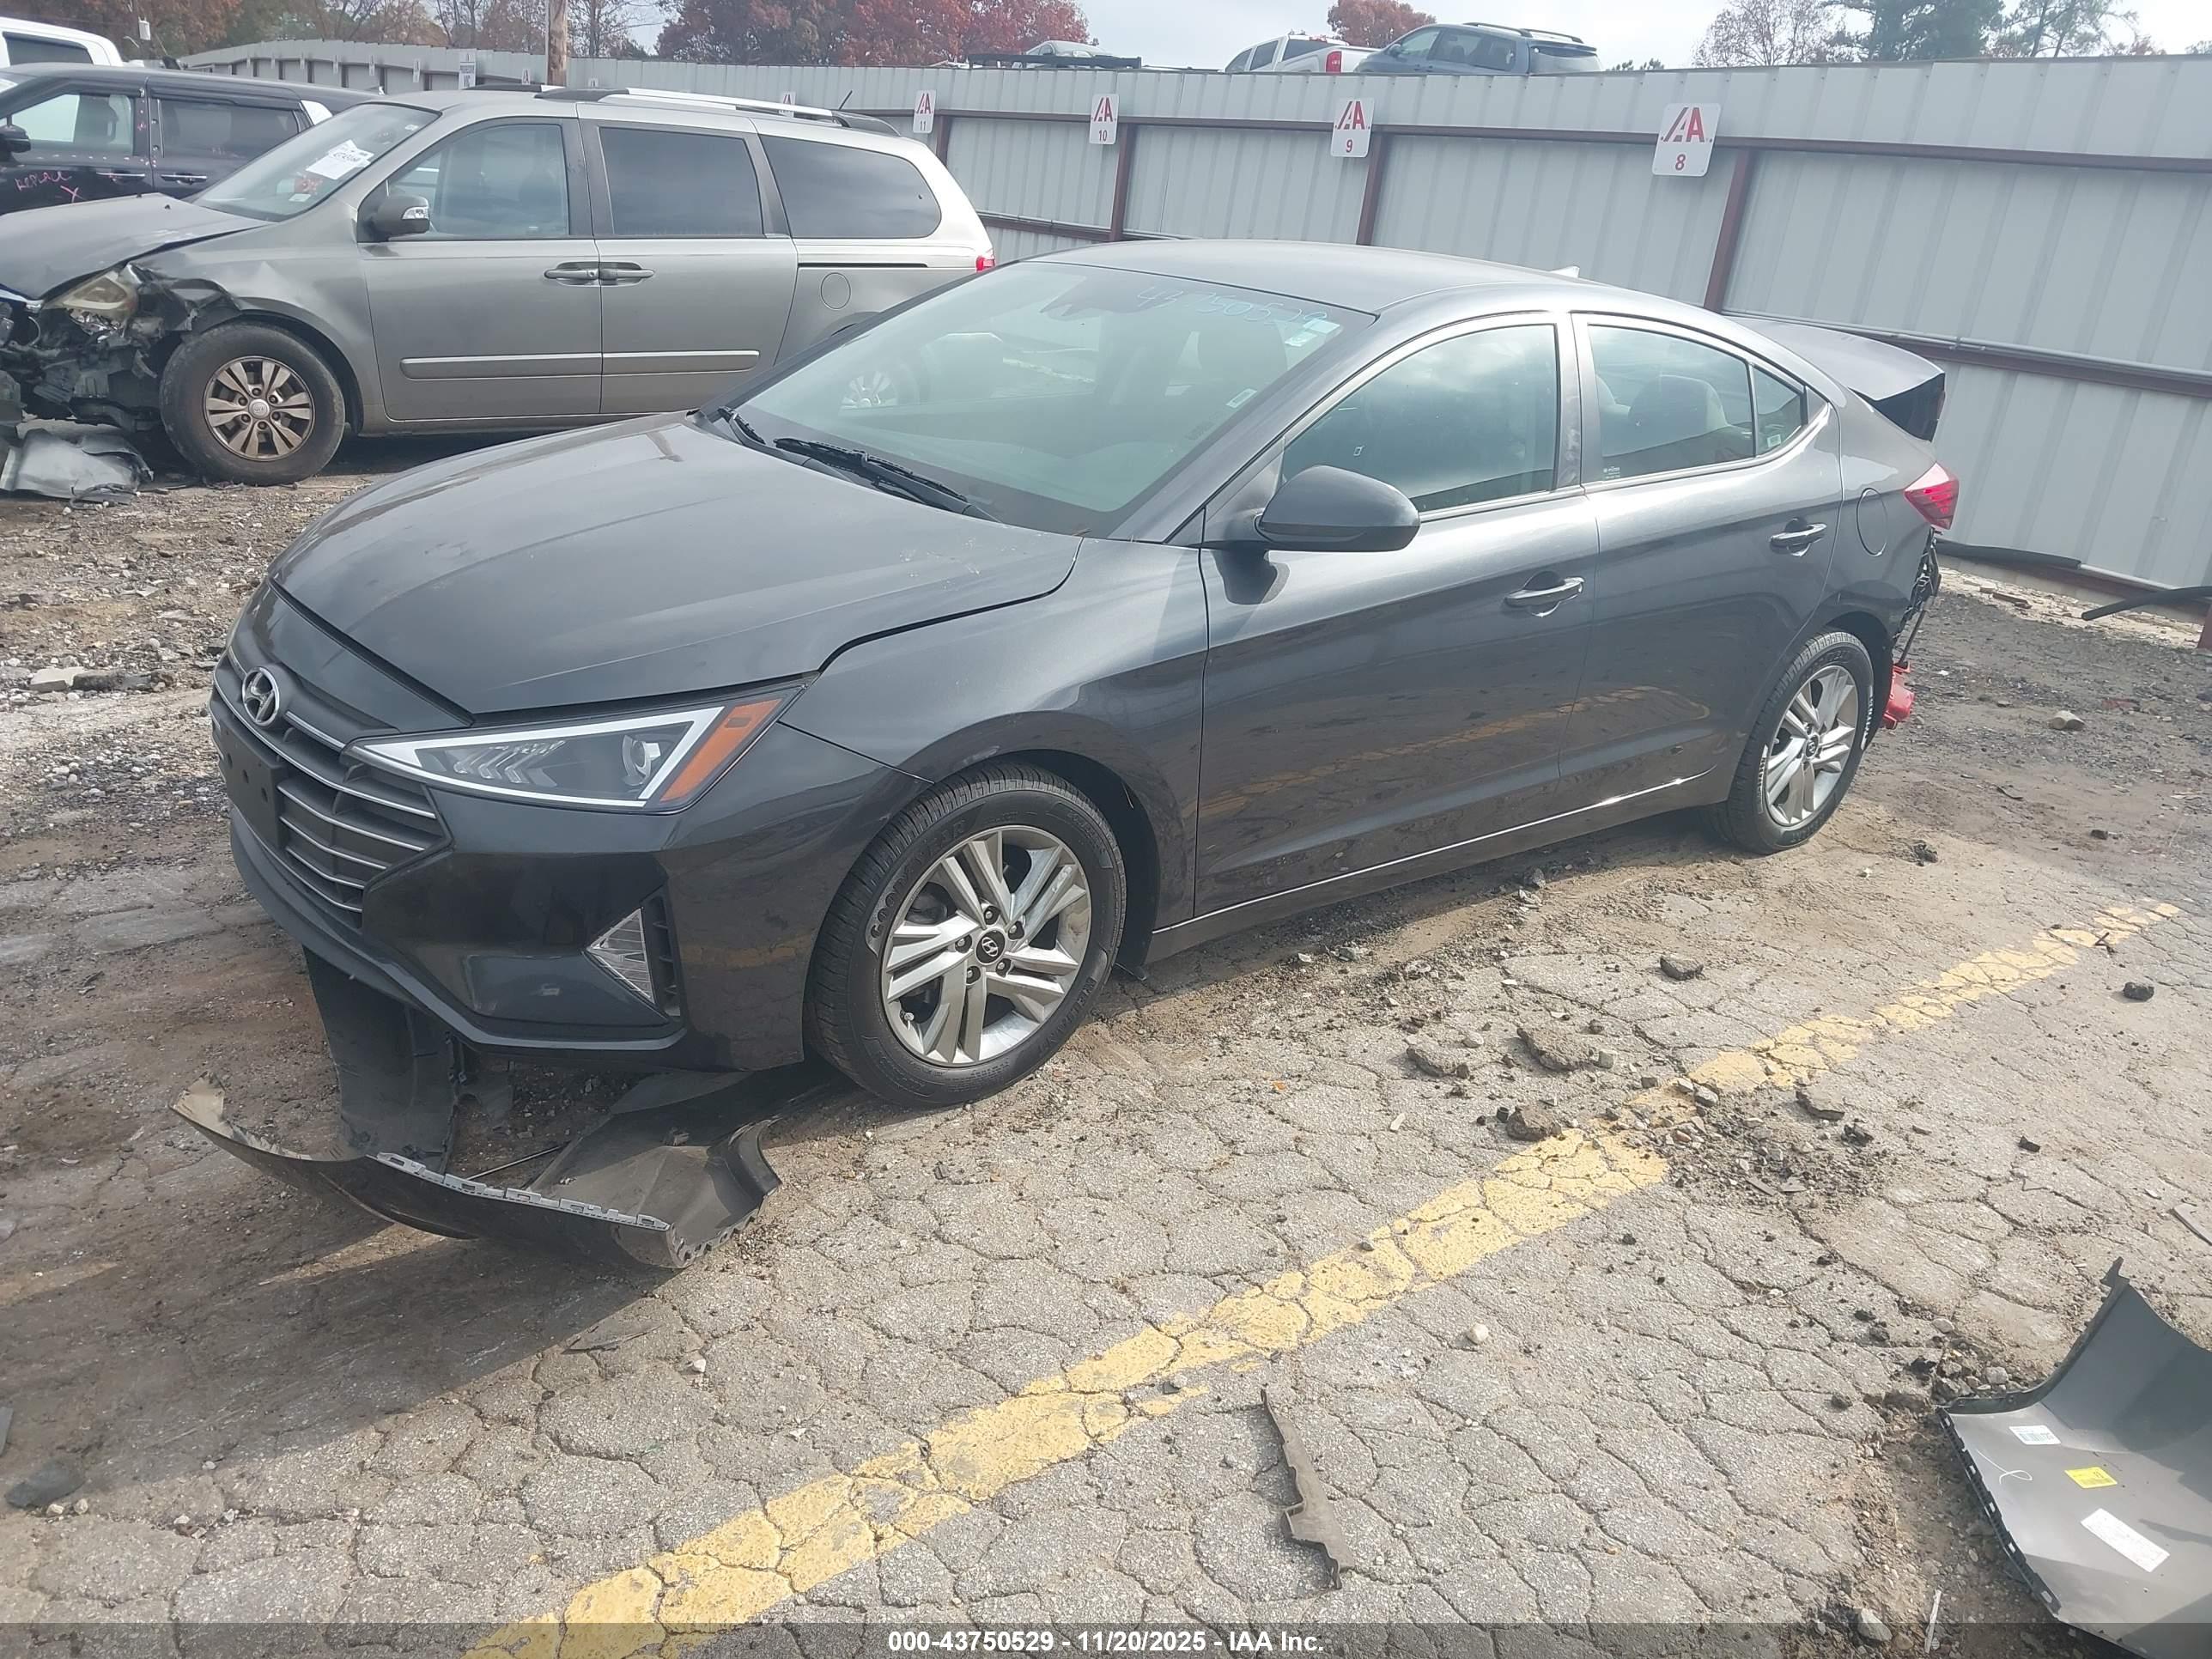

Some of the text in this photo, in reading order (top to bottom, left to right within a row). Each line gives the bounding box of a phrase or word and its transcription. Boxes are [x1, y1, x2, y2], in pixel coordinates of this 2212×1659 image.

[920, 120, 927, 131] 11
[1098, 130, 1108, 142] 10
[1346, 139, 1353, 153] 9
[1674, 153, 1686, 171] 8
